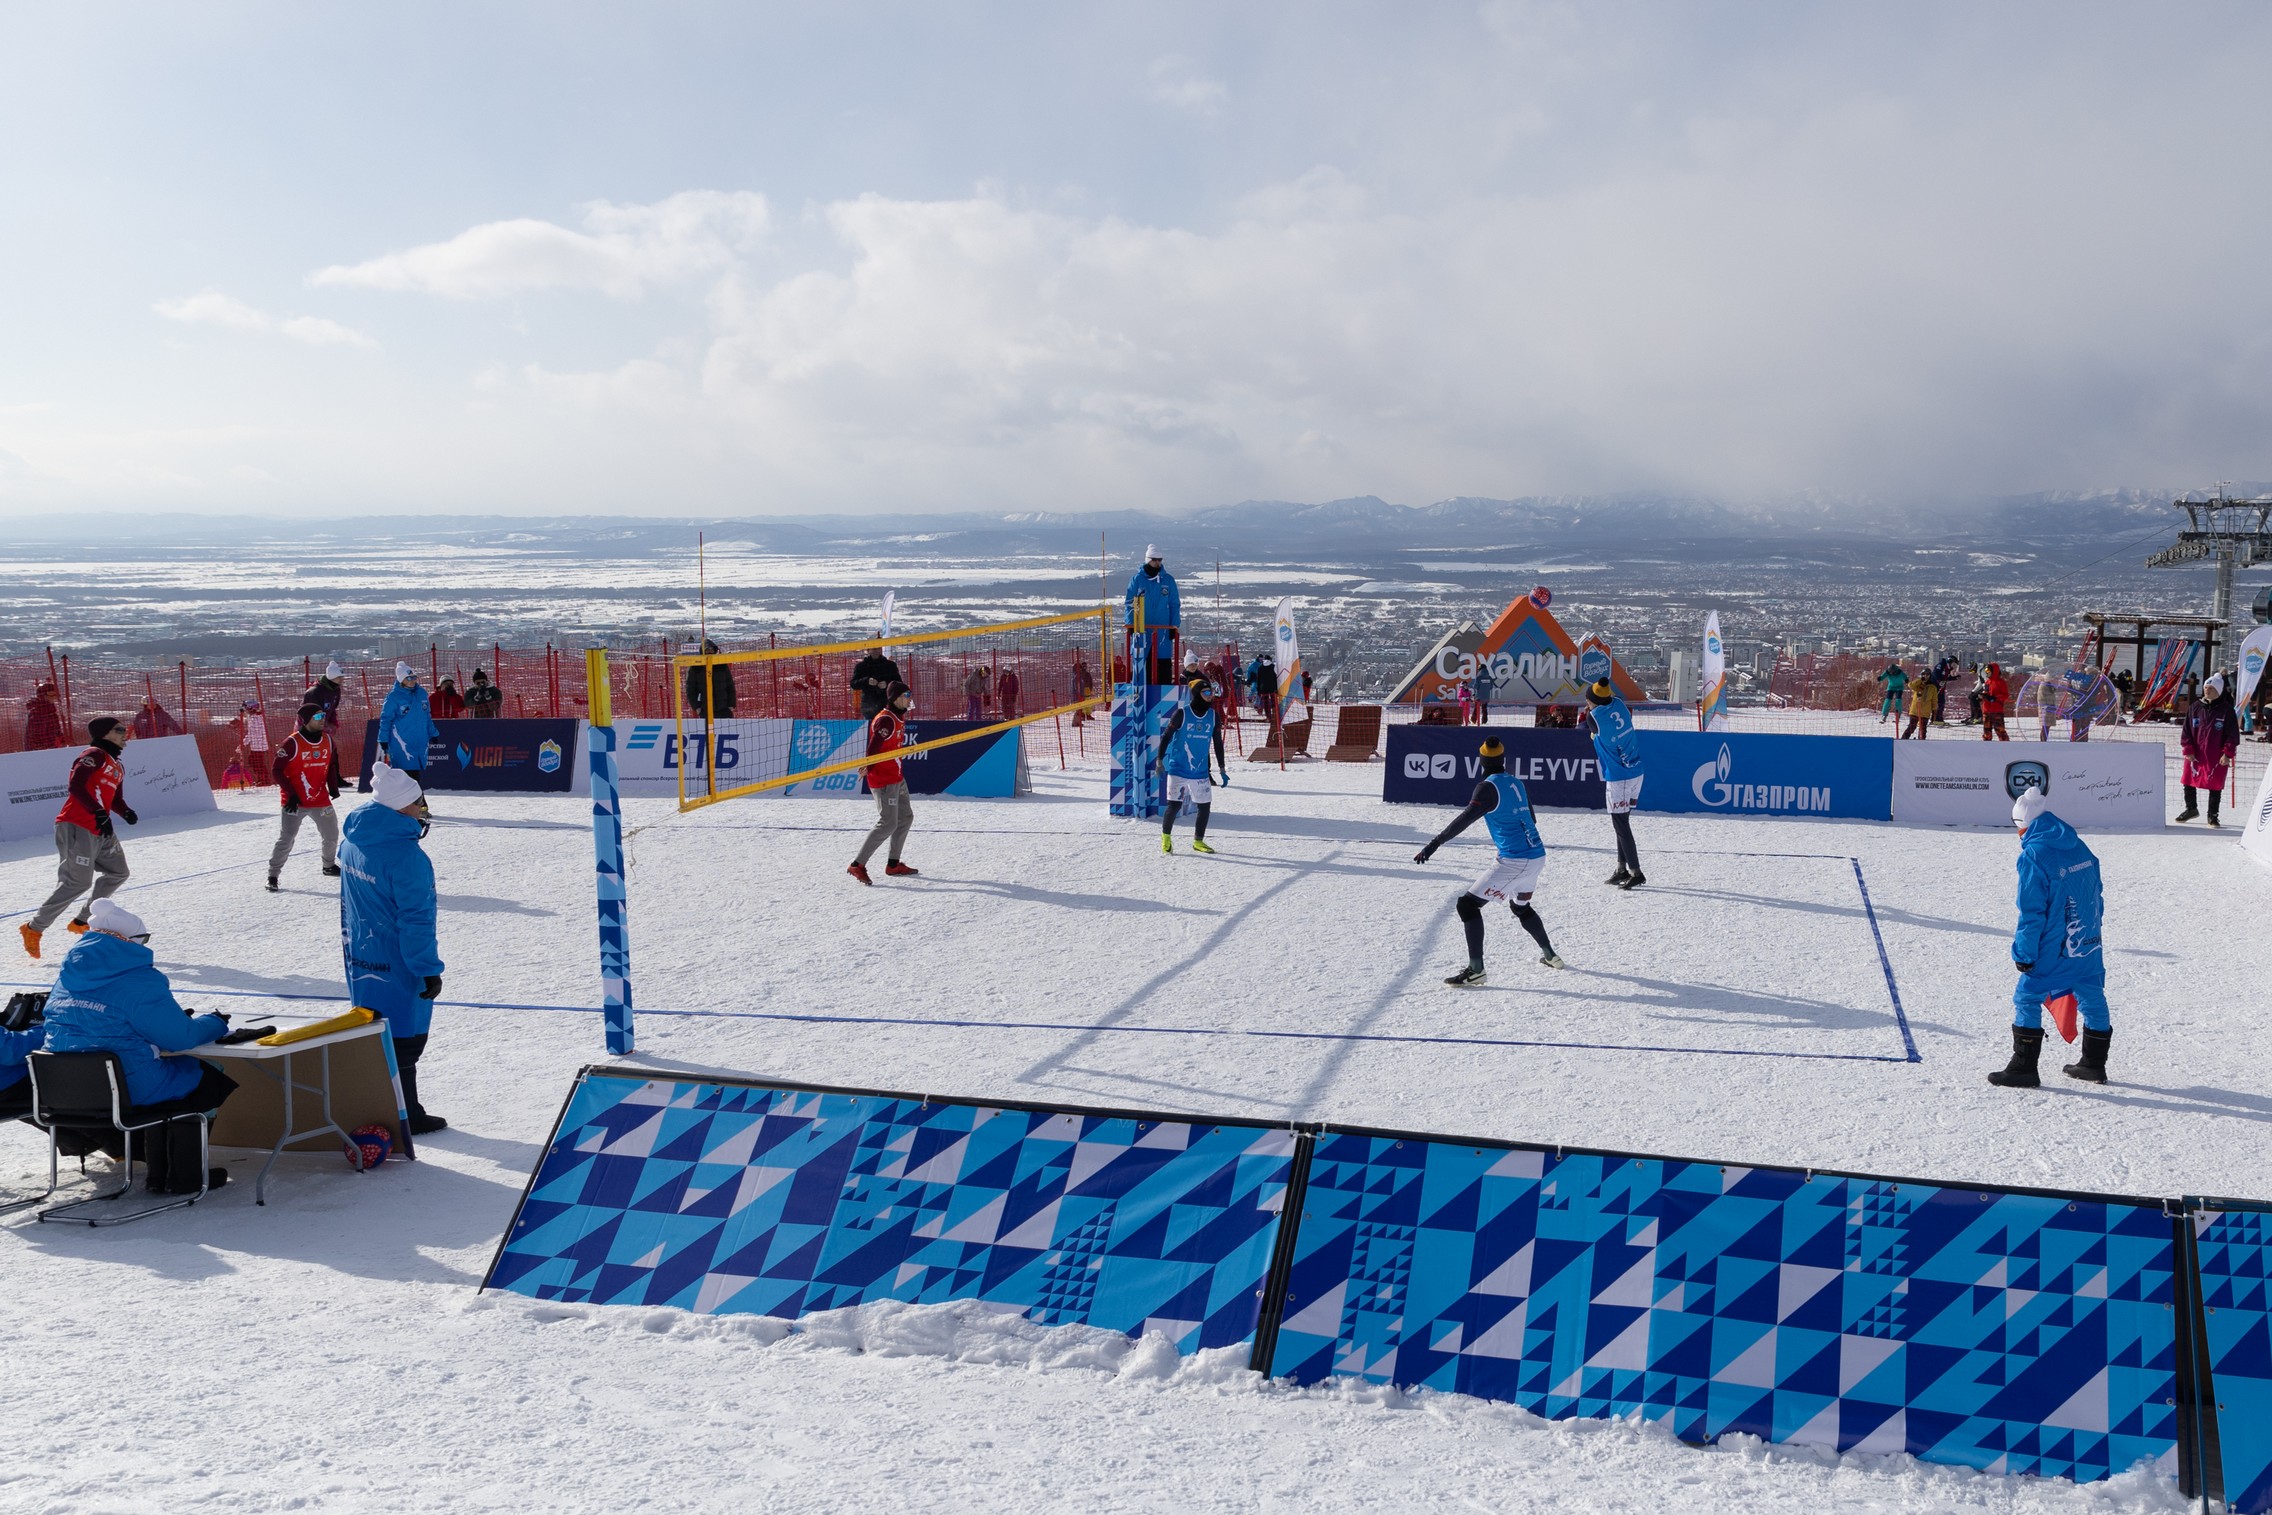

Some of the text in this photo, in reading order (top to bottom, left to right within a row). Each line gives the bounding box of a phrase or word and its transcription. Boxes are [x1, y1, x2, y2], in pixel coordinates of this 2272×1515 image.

[1435, 645, 1578, 680] Сахалин
[1205, 723, 1211, 733] 2
[1610, 711, 1625, 730] 3
[321, 748, 328, 759] 2
[474, 746, 503, 768] ЦСП
[663, 734, 740, 769] ВТБ
[812, 773, 859, 791] ВФВ
[1510, 782, 1523, 802] 1
[1914, 782, 1990, 791] WWW.ONETEAMSAKHALIN.COM
[1732, 783, 1832, 812] ГАЗПРОМ
[5, 1000, 41, 1026] 1 0
